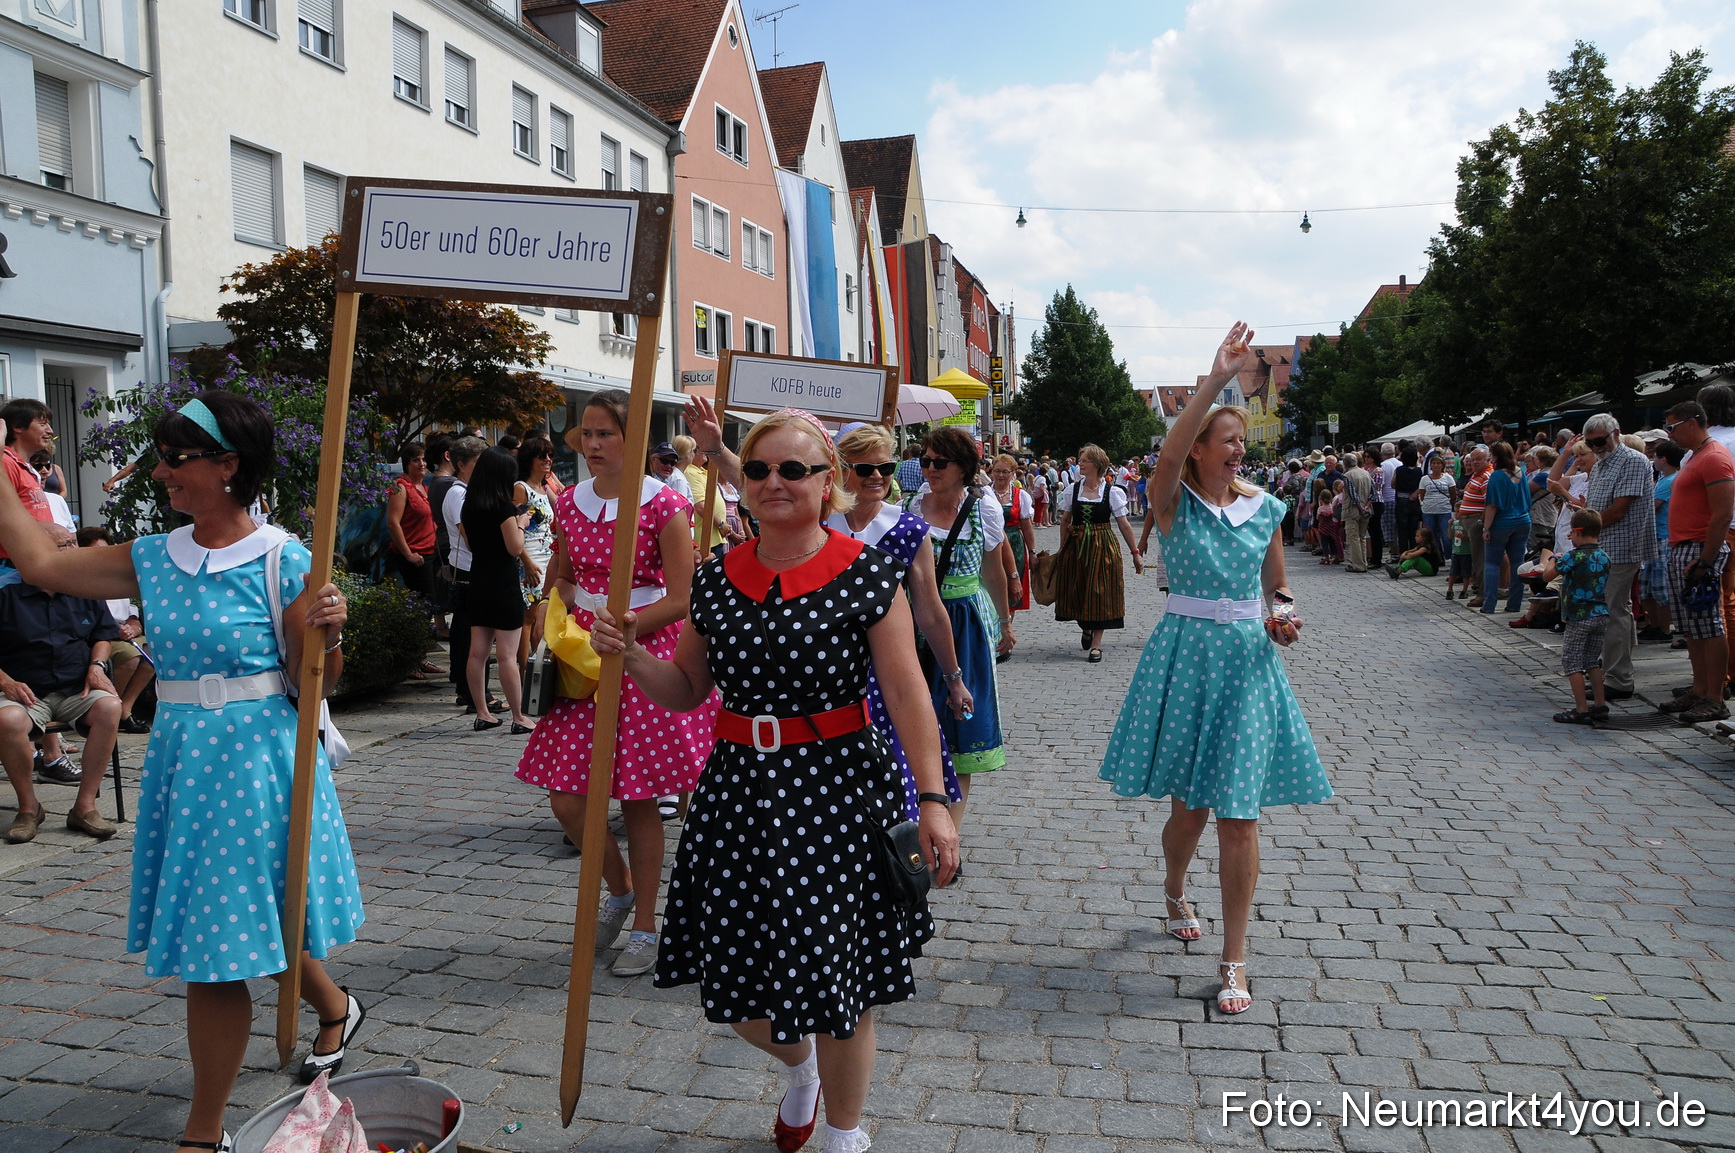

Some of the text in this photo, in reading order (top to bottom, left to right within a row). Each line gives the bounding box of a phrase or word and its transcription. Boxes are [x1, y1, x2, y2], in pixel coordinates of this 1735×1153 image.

[380, 220, 611, 263] 50er und 60er Jahre
[770, 376, 842, 399] KDFB heute
[990, 357, 1003, 419] HOTEL
